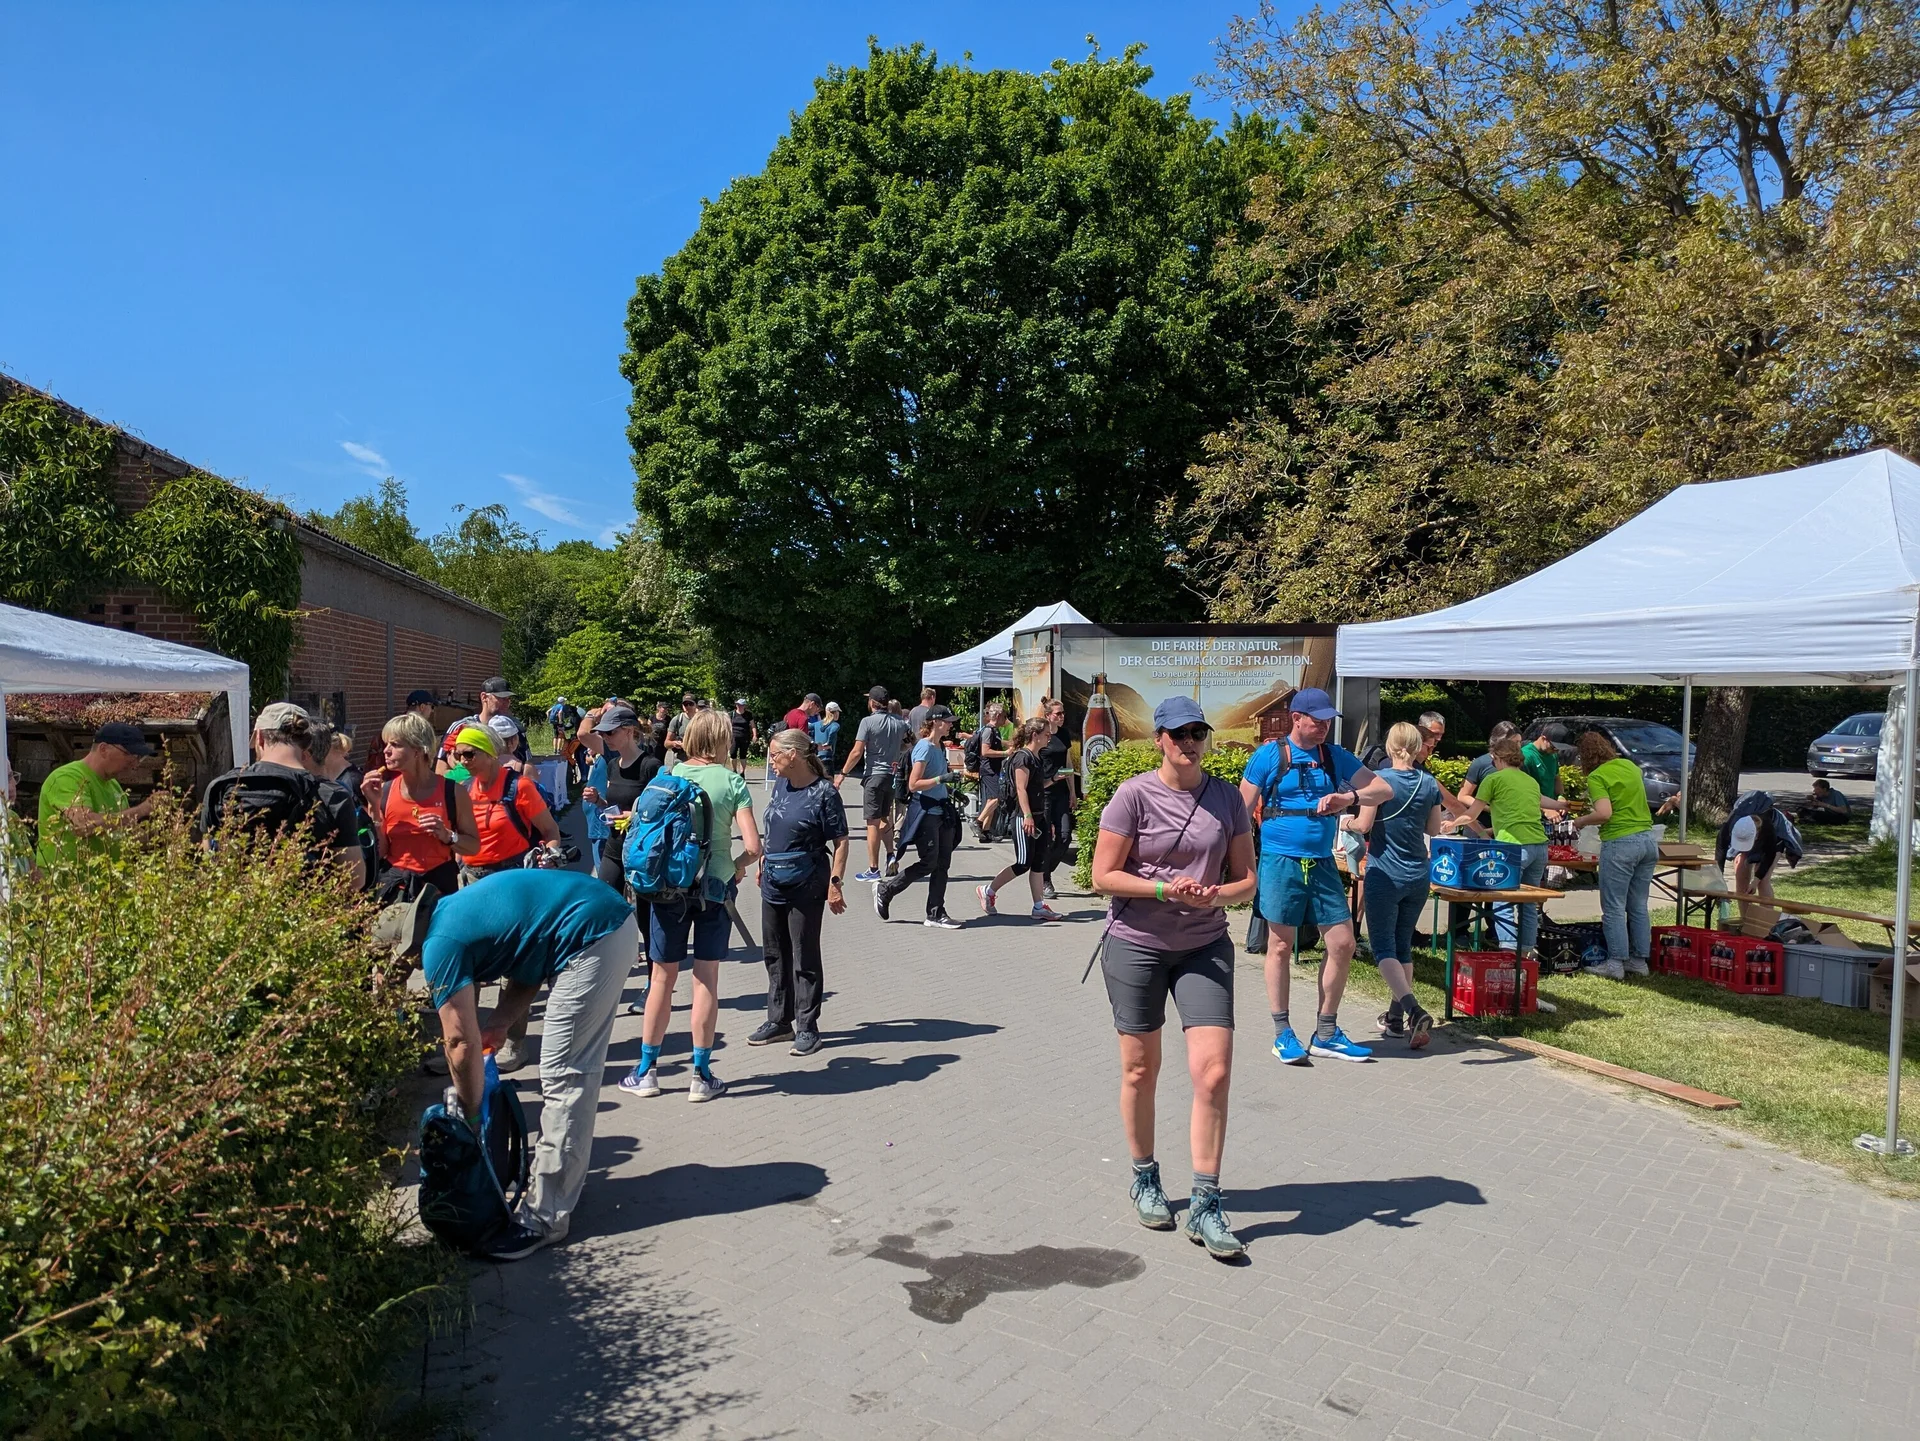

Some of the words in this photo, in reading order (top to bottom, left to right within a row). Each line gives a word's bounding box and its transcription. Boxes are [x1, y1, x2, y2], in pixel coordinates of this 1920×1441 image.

[1151, 640, 1171, 651] DIE
[1173, 640, 1210, 651] FARBE
[1213, 640, 1236, 651] DER
[1238, 640, 1282, 651] NATUR.
[1119, 656, 1142, 666] DER
[1145, 656, 1217, 666] GESCHMACK
[1220, 656, 1243, 666] DER
[1246, 656, 1313, 666] TRADITION.
[1152, 670, 1167, 678] Das
[1188, 670, 1237, 678] Franziskaner
[1238, 670, 1275, 678] Kellerbier
[1168, 678, 1211, 688] vollmundig
[1211, 679, 1227, 687] und
[1228, 679, 1267, 687] unfiltriert.
[1554, 961, 1580, 969] Krombacher
